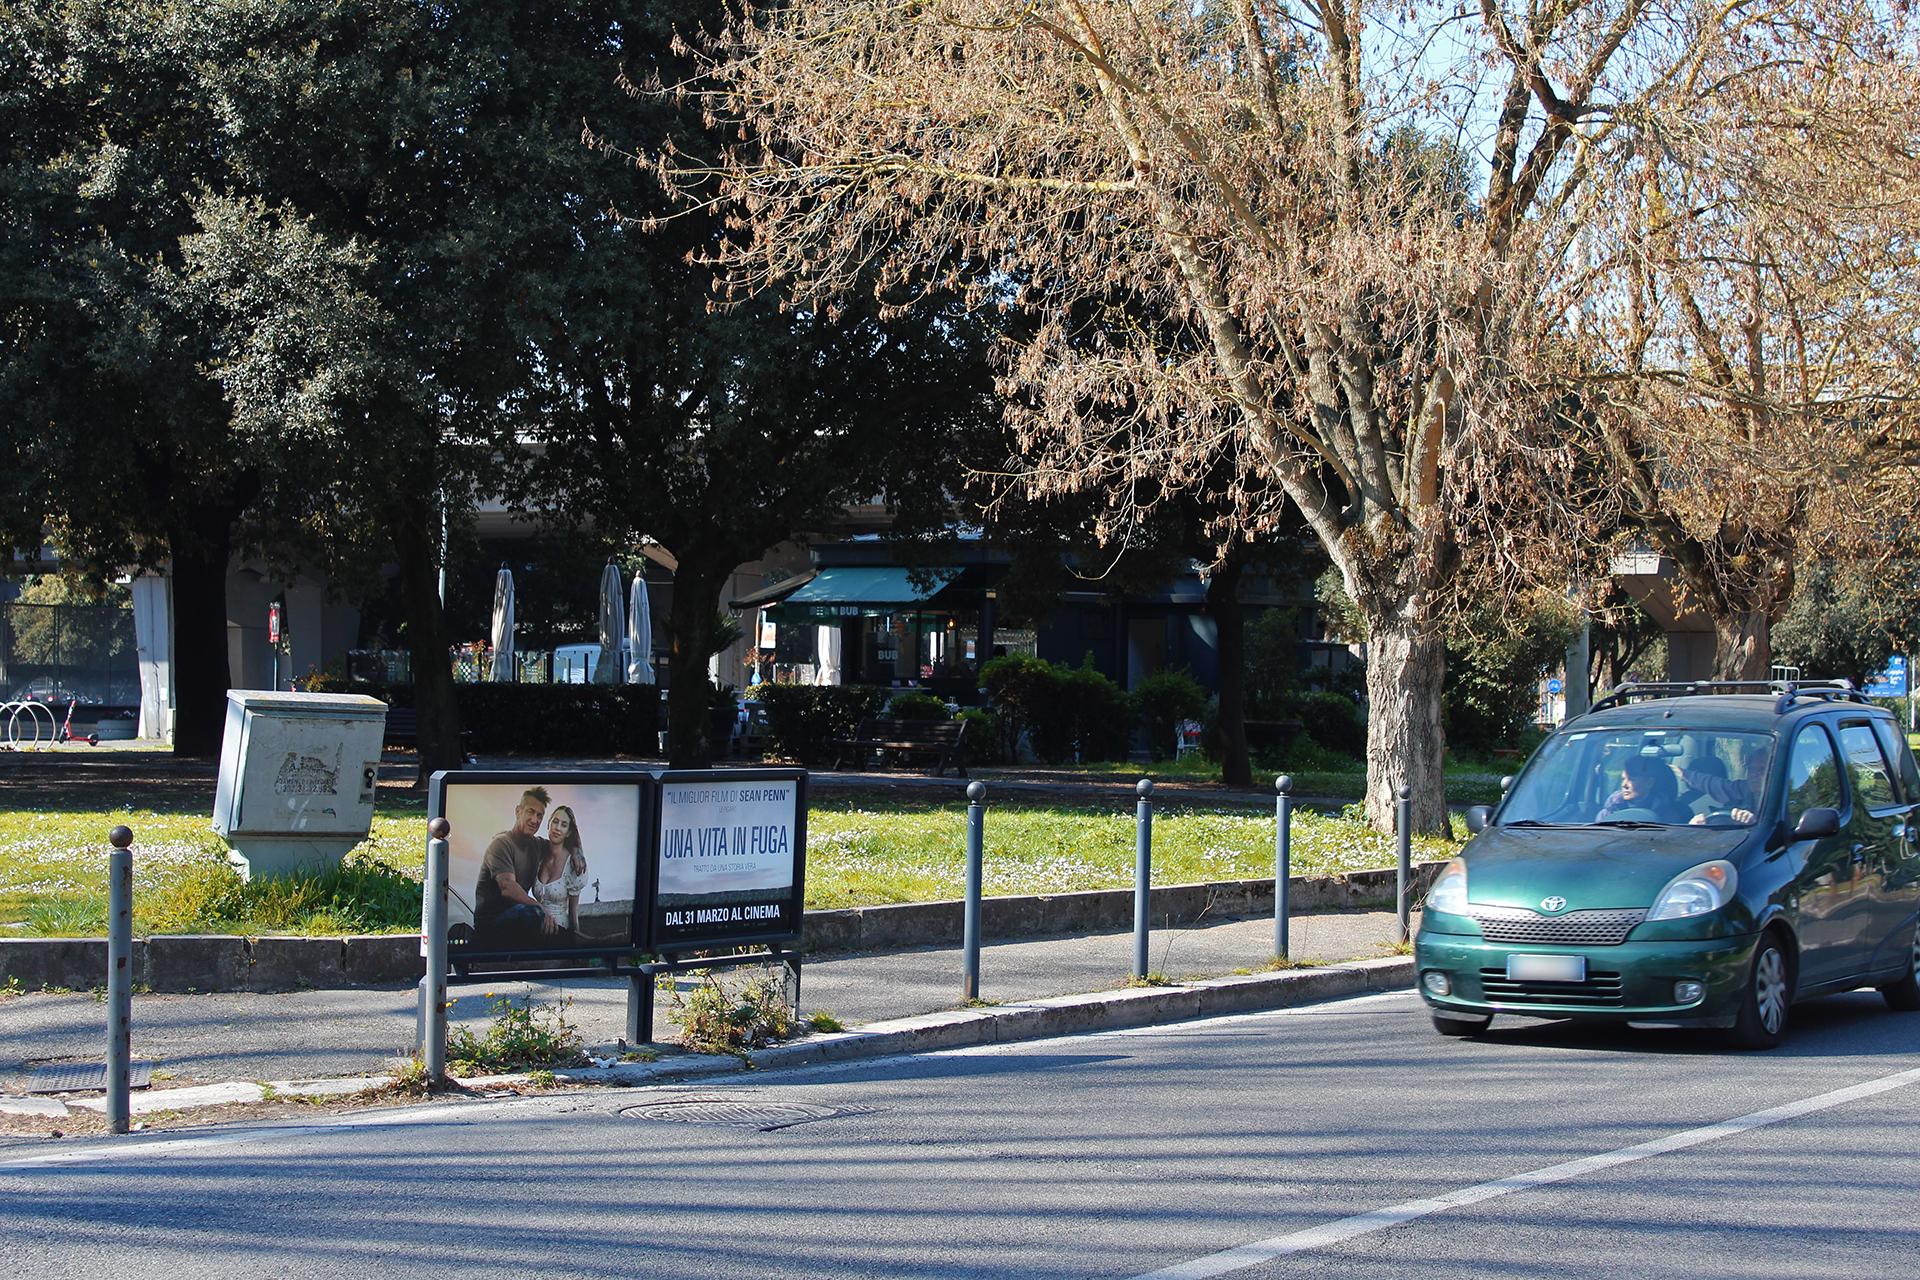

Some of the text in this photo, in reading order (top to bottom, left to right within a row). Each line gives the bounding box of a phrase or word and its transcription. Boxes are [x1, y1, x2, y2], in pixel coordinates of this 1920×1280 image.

[840, 606, 859, 616] BUB
[878, 650, 898, 660] BUB
[679, 790, 709, 804] MIGLIOR
[711, 790, 729, 803] FILM
[730, 790, 738, 803] DI
[739, 789, 761, 802] SEAN
[664, 825, 788, 859] UNA VITA IN FUGA
[665, 904, 780, 926] DAL 31 MARZO AL CINEMA
